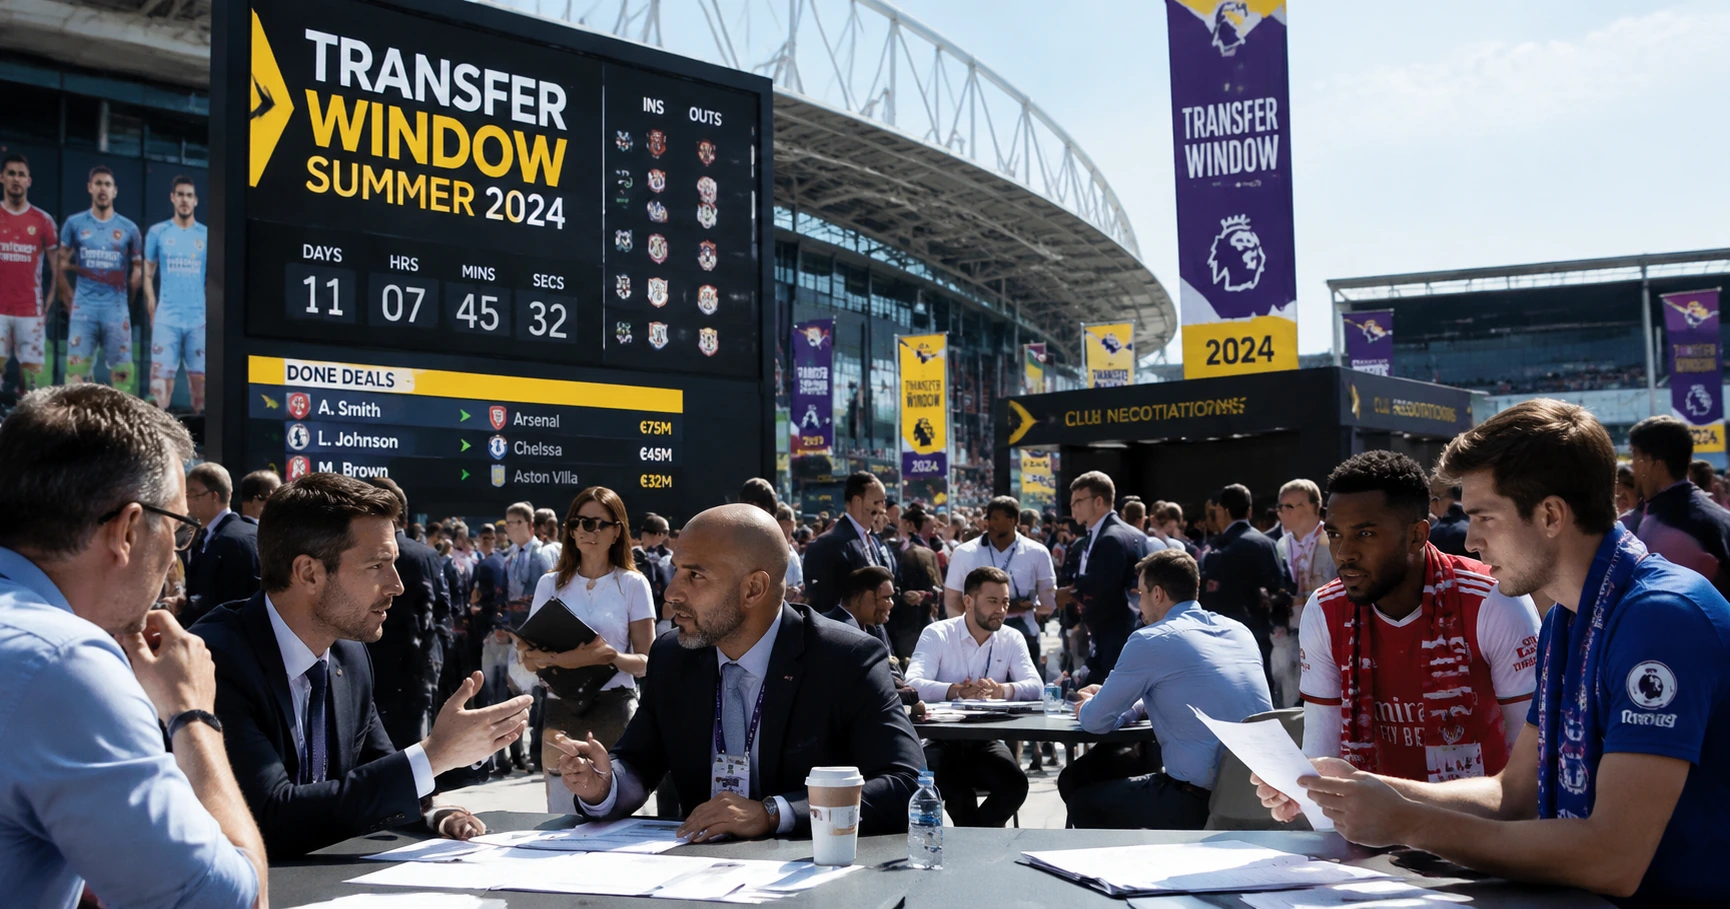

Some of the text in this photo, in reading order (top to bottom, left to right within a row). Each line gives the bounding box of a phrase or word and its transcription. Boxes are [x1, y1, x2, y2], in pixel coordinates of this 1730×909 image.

[304, 28, 567, 130] TRANSFER
[643, 96, 665, 115] INS
[689, 106, 723, 126] OUTS
[1181, 97, 1279, 139] TRANSFER
[305, 88, 567, 188] WINDOW
[1184, 134, 1279, 179] WINDOW
[305, 155, 566, 230] SUMMER 2024
[303, 243, 343, 263] DAYS
[390, 254, 419, 272] HRS
[462, 264, 496, 282] MINS
[533, 273, 565, 290] SECS
[303, 275, 343, 316] 11
[382, 284, 426, 323] 07
[456, 293, 499, 331] 45
[528, 301, 567, 339] 32
[1205, 335, 1275, 366] 2024
[287, 365, 395, 388] DONE DEALS
[318, 399, 381, 418] A. Smith
[513, 411, 560, 428] Arsenal
[639, 420, 672, 435] €75M
[318, 430, 399, 449] L. Johnson
[639, 446, 672, 462] €45M
[318, 461, 389, 478] M. Brown
[513, 469, 550, 484] Aston
[640, 473, 672, 488] €32M
